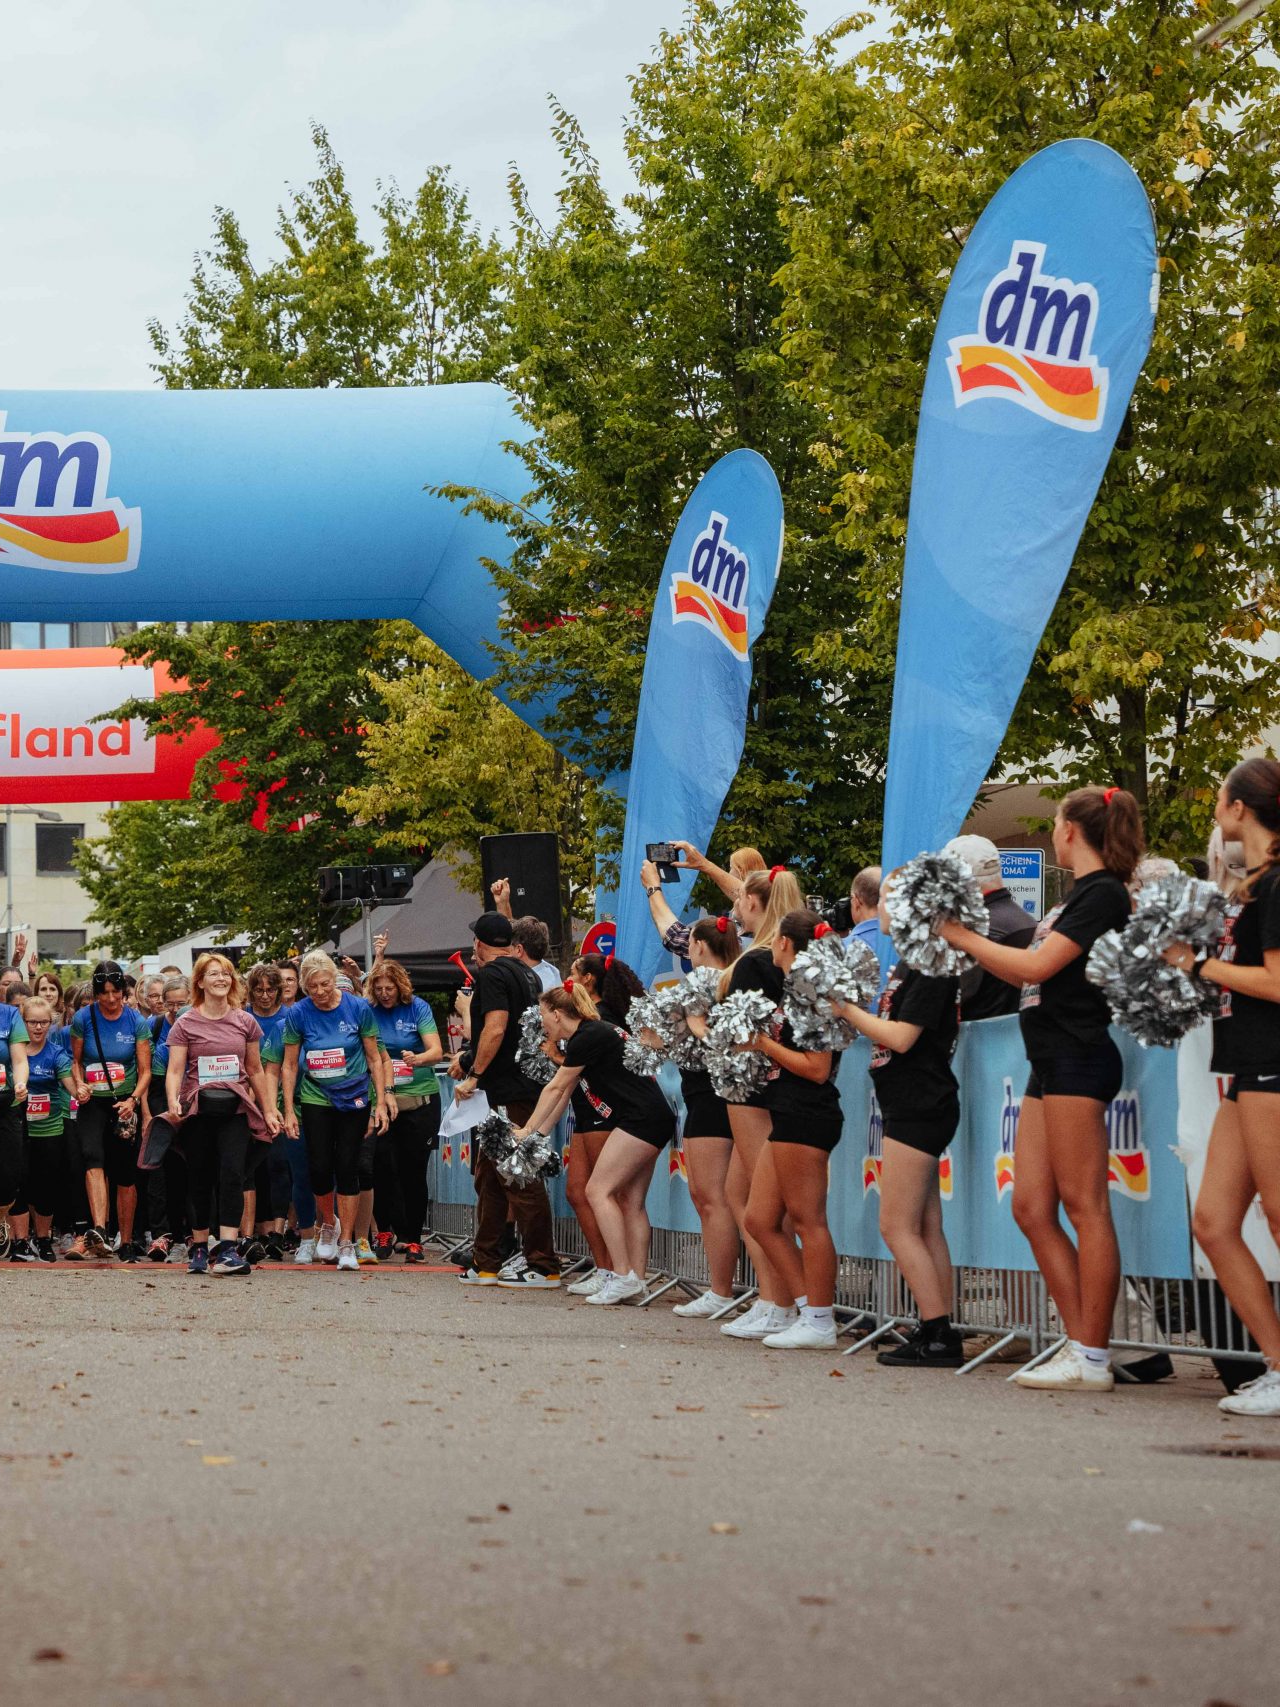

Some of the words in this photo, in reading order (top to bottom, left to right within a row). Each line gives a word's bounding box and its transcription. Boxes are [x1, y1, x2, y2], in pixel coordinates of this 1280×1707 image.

[985, 252, 1092, 361] dm
[691, 520, 747, 607] dm
[1001, 857, 1036, 866] SCHEIN-
[1008, 885, 1036, 893] kschein
[310, 1056, 342, 1066] Roswitha
[208, 1063, 229, 1072] Maria
[94, 1071, 117, 1081] 175
[26, 1103, 42, 1112] 764
